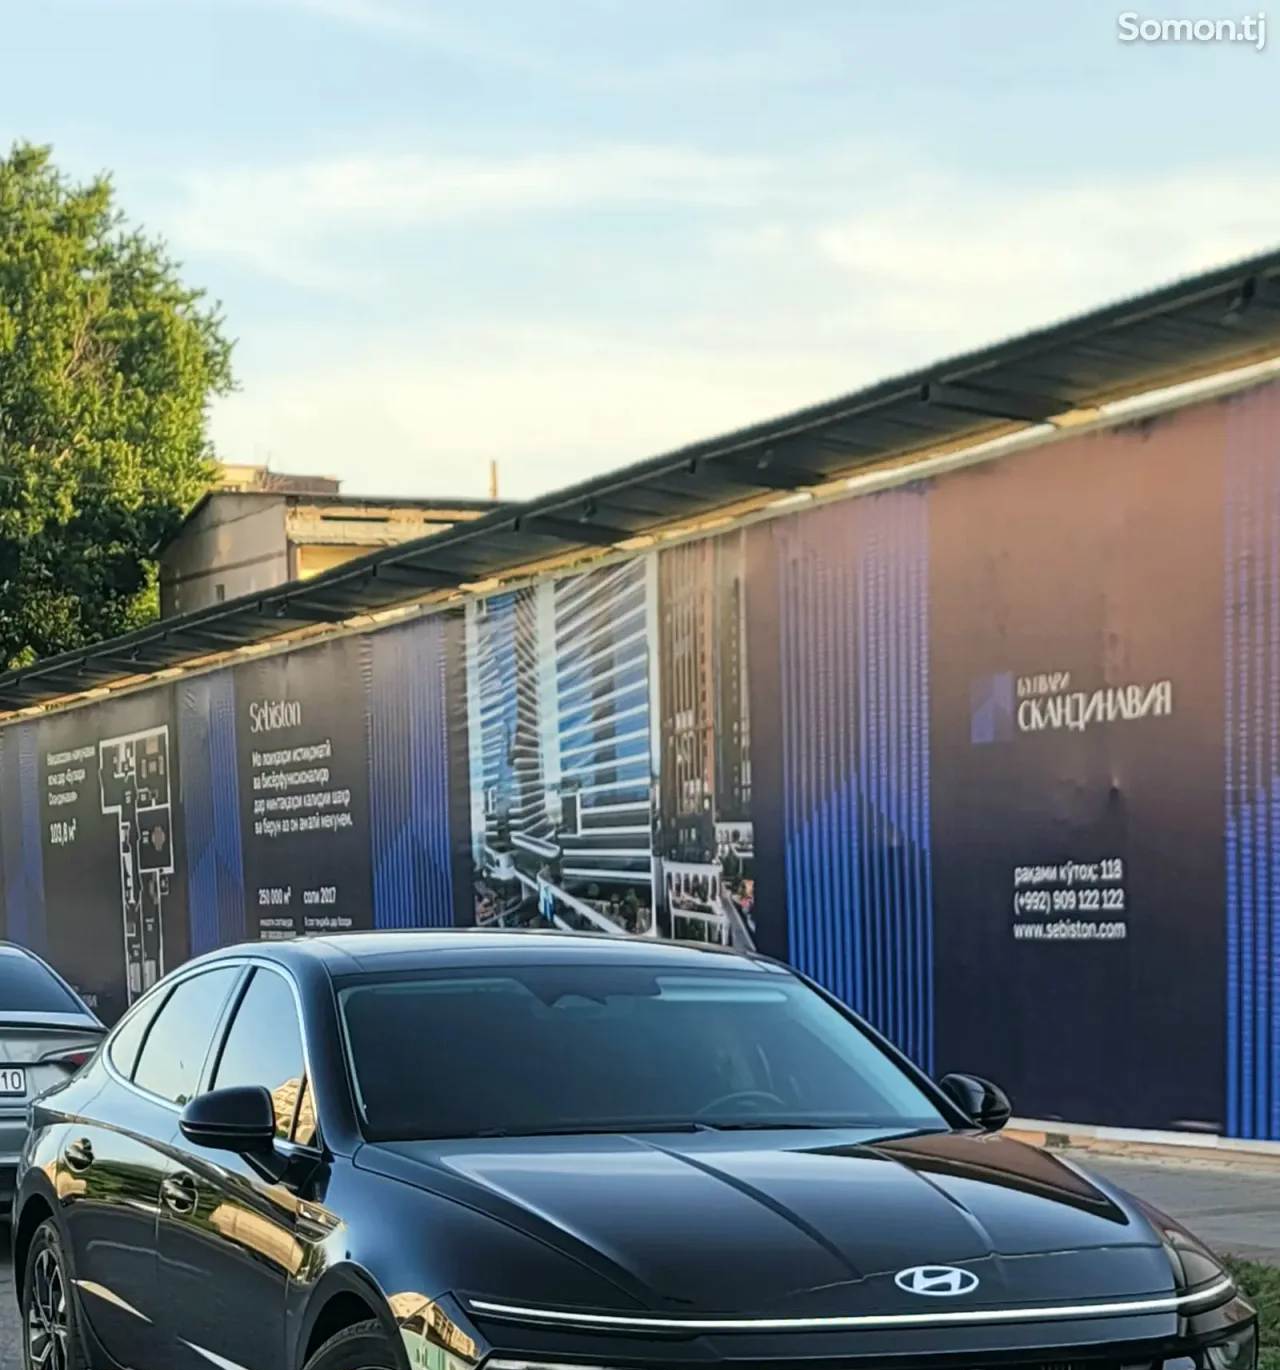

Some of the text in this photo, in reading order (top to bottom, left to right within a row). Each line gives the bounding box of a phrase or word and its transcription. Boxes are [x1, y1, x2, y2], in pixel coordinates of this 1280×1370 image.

[250, 700, 301, 732] Sebiston
[1017, 680, 1172, 732] СКАНДИНАВИЯ
[1014, 887, 1124, 915] (+992) 909 122 122
[1013, 918, 1126, 939] www.sebiston.com
[1, 1071, 21, 1090] 10
